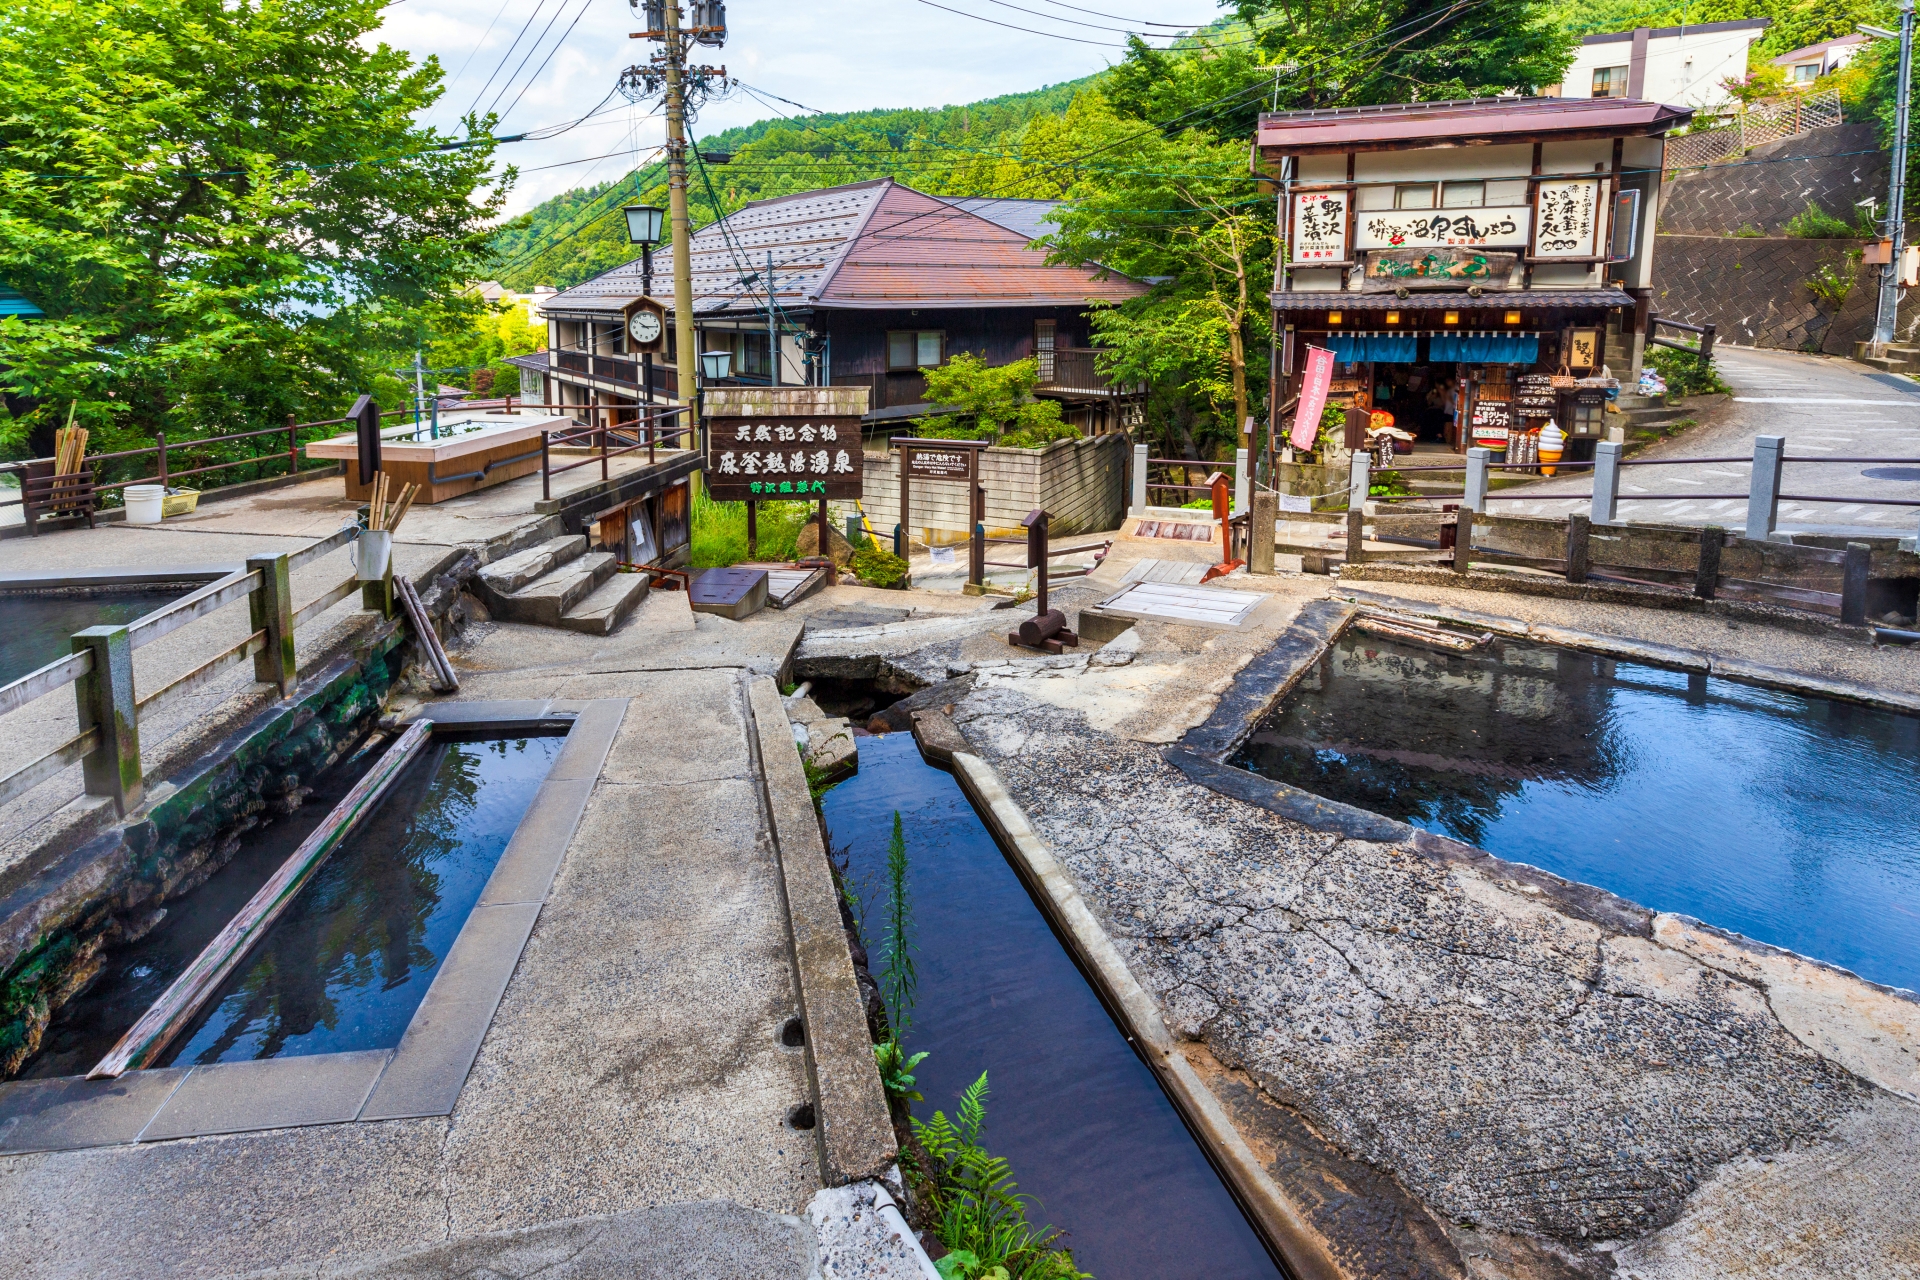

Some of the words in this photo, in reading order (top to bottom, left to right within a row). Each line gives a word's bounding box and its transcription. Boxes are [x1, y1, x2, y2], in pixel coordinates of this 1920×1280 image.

[1321, 199, 1343, 236] 野沢
[1302, 251, 1333, 259] 直売所
[1489, 418, 1508, 426] ソフト
[735, 423, 837, 442] 天然記念物
[718, 449, 854, 475] 麻釜熱湯湧泉
[750, 480, 826, 494] 野沢組惣代
